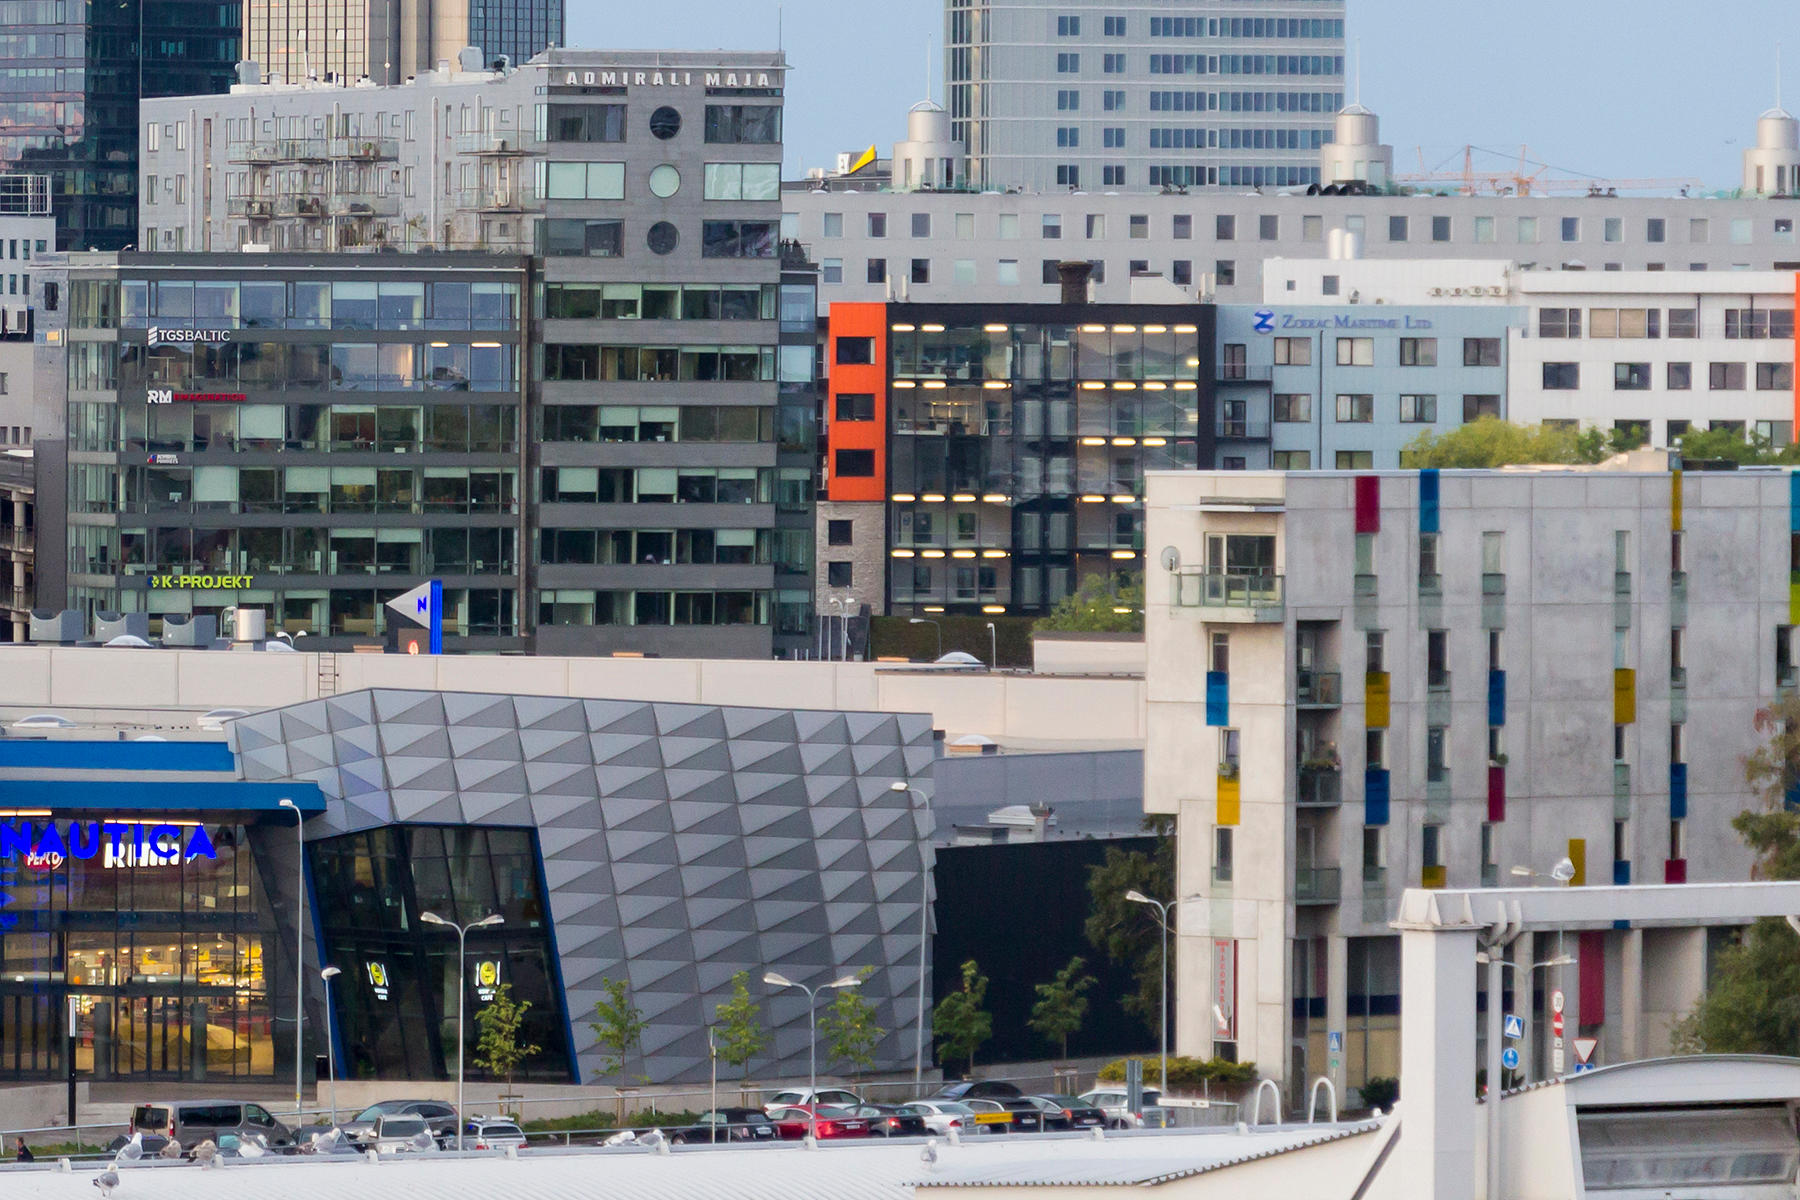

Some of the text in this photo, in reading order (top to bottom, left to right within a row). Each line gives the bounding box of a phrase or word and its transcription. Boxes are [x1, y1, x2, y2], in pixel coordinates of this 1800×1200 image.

[566, 71, 770, 87] ADMIRALI MAJA
[147, 390, 172, 403] RM
[162, 575, 254, 589] K-PROJEKT
[0, 822, 217, 860] NAUTICA
